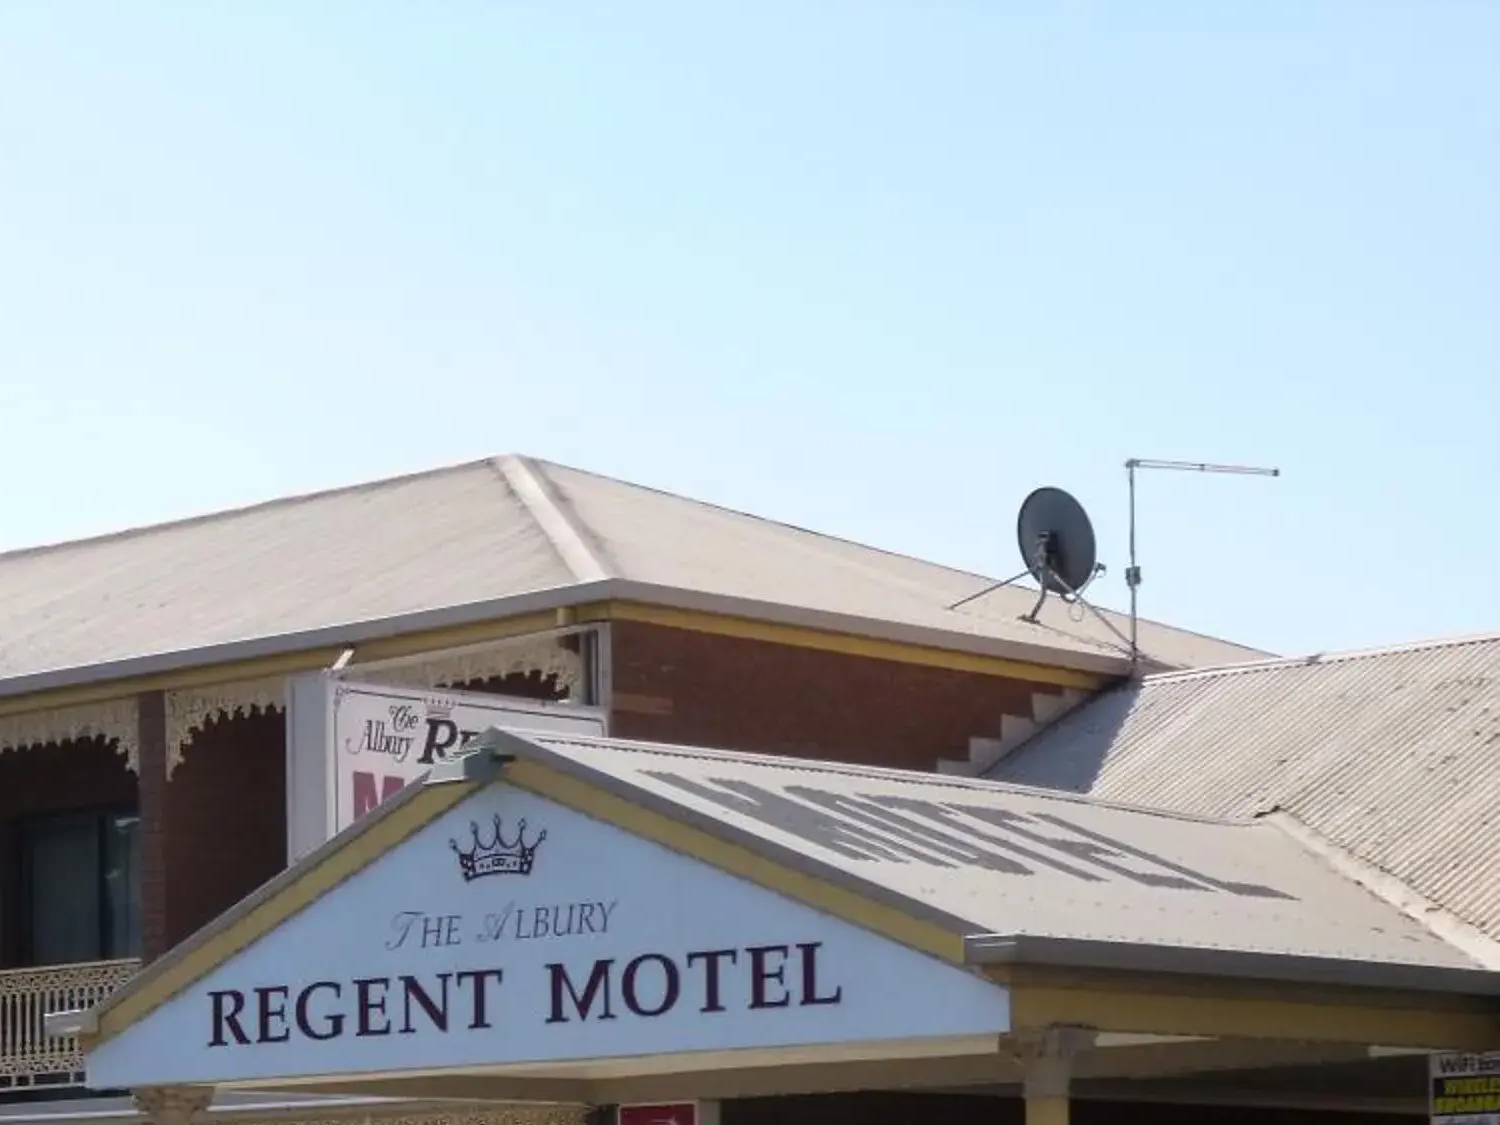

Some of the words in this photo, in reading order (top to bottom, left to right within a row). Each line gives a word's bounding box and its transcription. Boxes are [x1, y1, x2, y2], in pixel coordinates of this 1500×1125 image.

[345, 719, 415, 763] Albury
[388, 705, 419, 732] The
[384, 910, 463, 951] THE
[476, 899, 619, 942] ALBURY
[206, 968, 504, 1048] REGENT
[544, 941, 842, 1025] MOTEL
